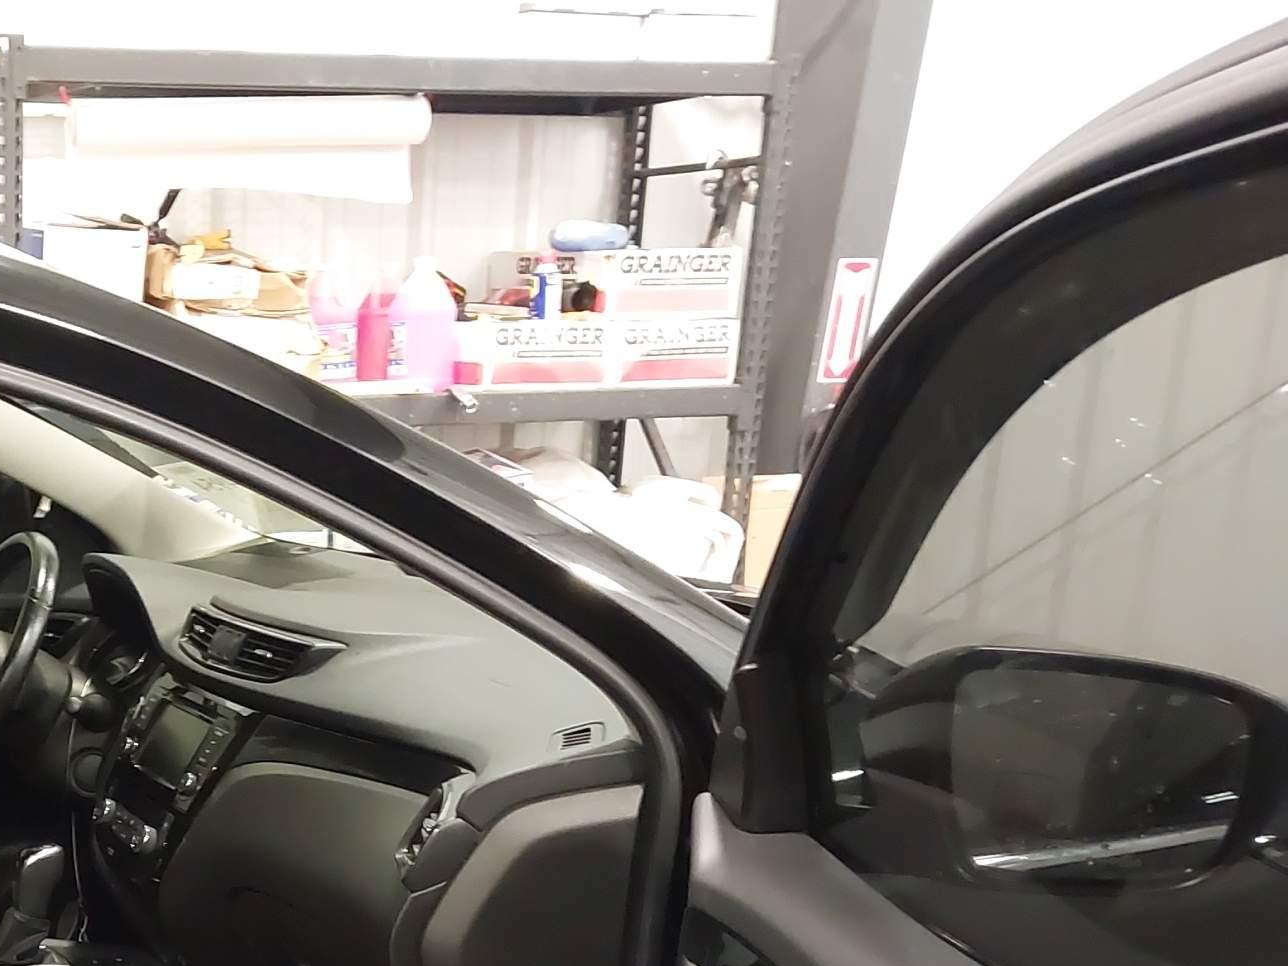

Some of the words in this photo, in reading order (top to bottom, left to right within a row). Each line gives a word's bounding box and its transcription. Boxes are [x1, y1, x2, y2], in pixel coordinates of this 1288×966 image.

[620, 254, 732, 274] GRAINGER
[496, 327, 604, 346] GRANGER
[624, 324, 731, 345] GRANGER
